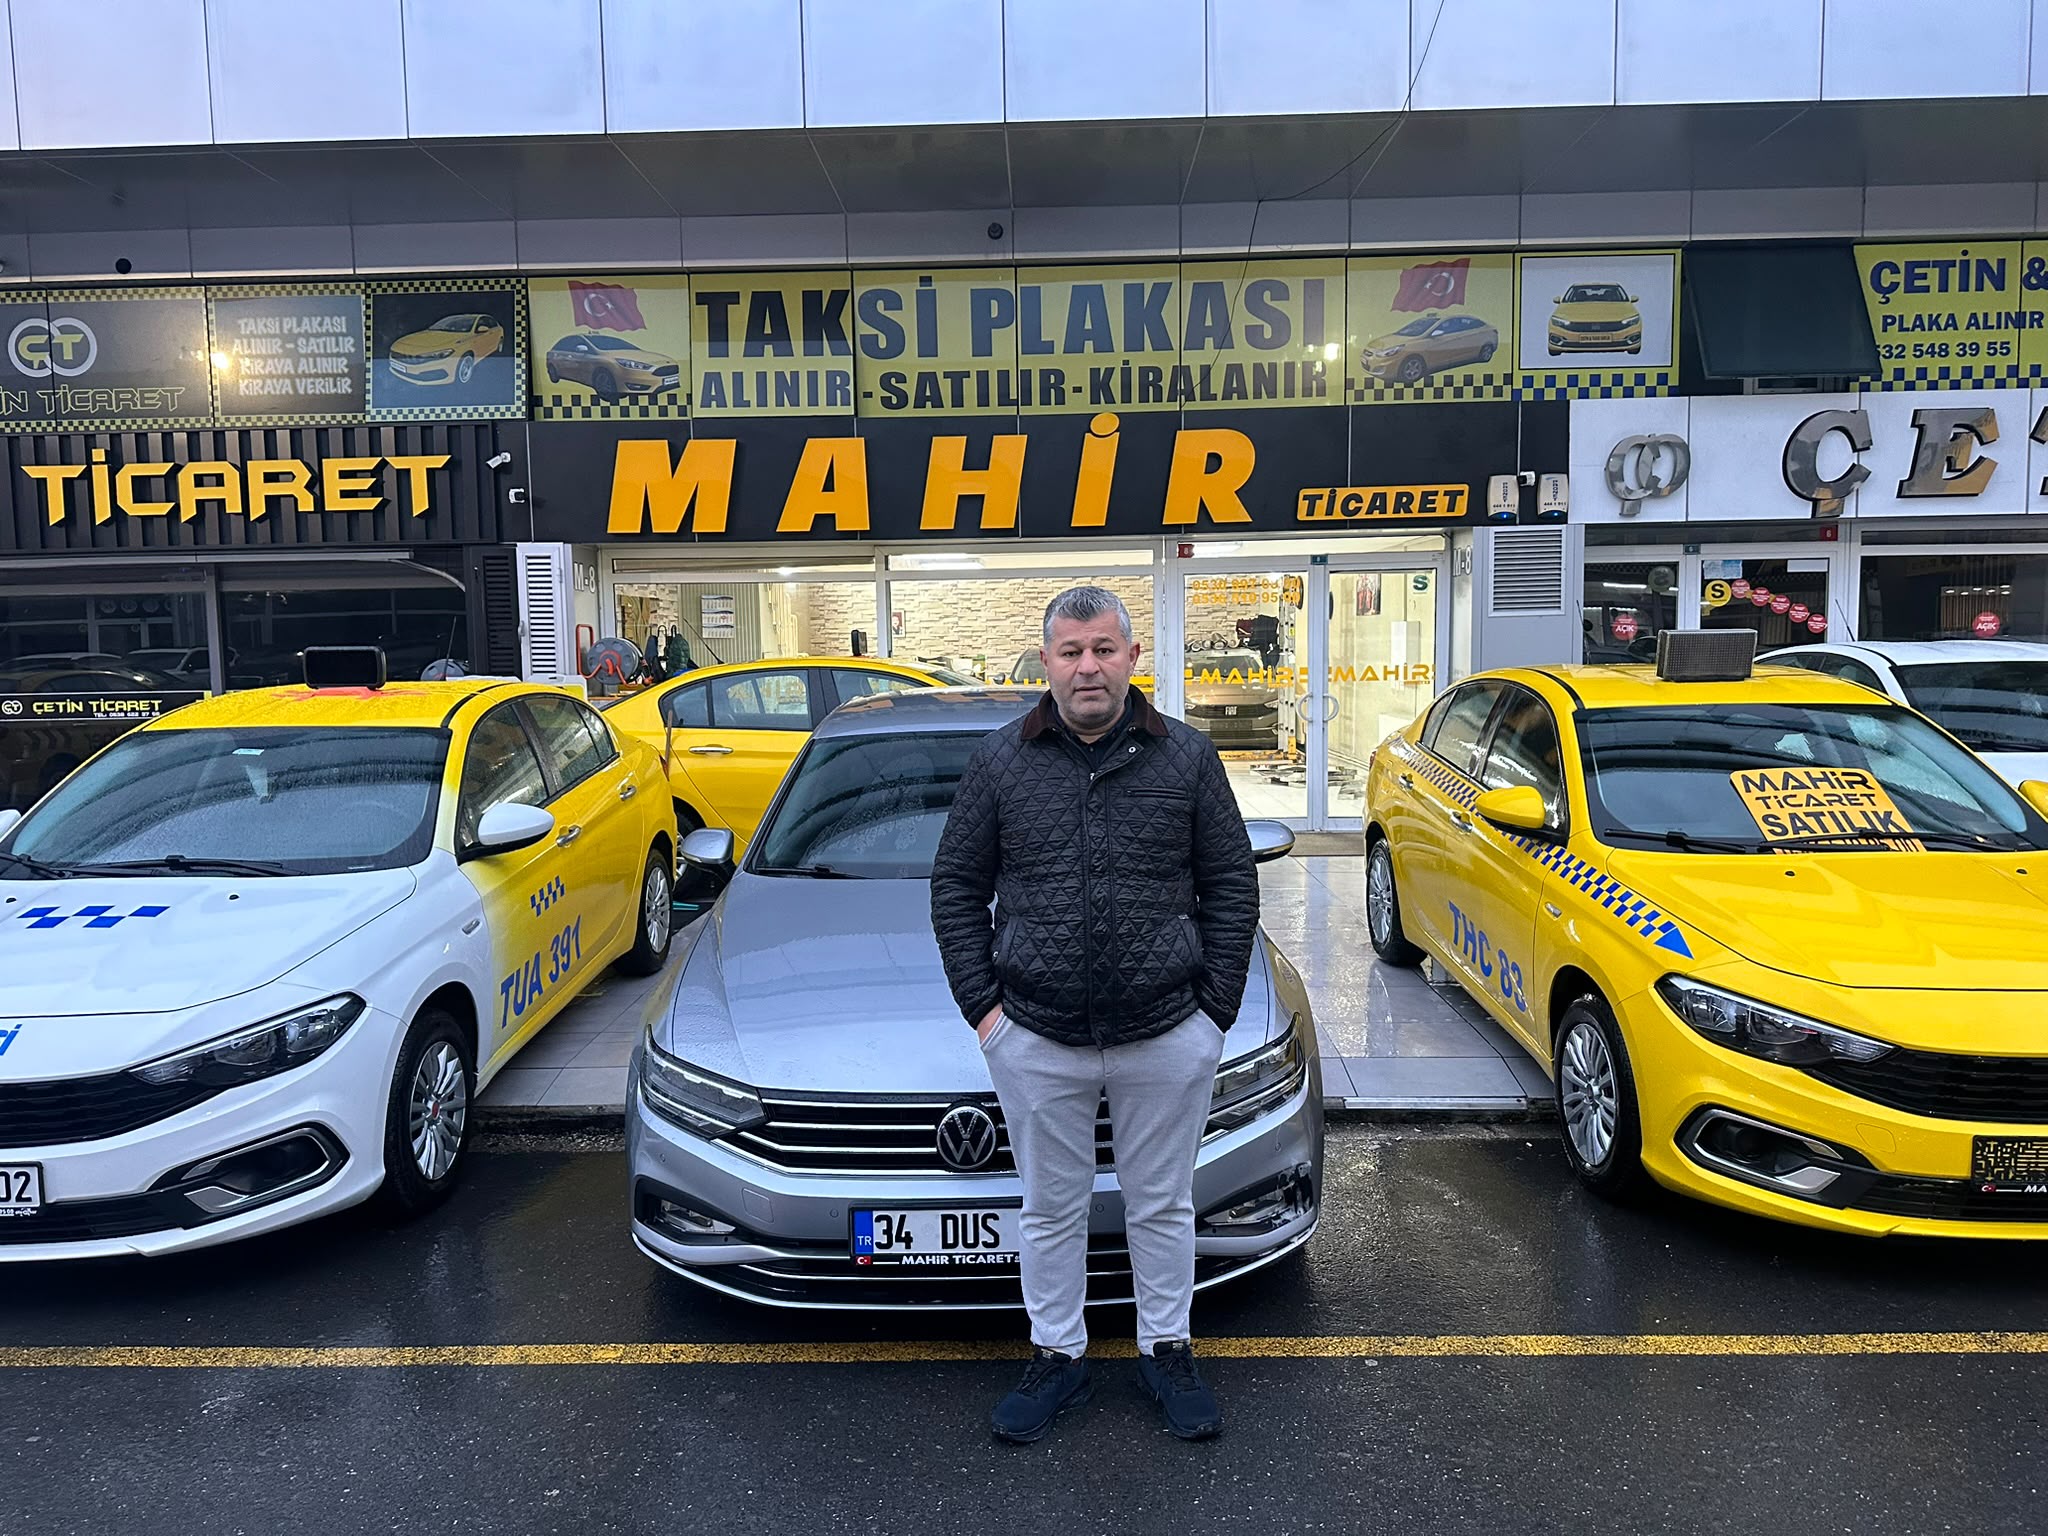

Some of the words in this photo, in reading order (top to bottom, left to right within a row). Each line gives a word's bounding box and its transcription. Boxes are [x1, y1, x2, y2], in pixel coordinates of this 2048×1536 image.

[1870, 249, 2006, 304] ÇETİN
[282, 316, 347, 334] PLAKASI
[696, 275, 938, 359] TAKSİ
[970, 279, 1325, 357] PLAKASI
[1882, 313, 1958, 333] PLAKA
[1965, 311, 2044, 331] ALINIR
[232, 338, 283, 355] ALINIR
[297, 336, 355, 354] SATILIR
[1912, 343, 1949, 359] 548
[1956, 342, 1980, 358] 39
[1987, 341, 2011, 356] 55
[298, 356, 348, 374] ALINIR
[37, 384, 185, 414] TİCARET
[607, 412, 1256, 534] MAHİR
[1782, 406, 2048, 518] ÇE
[20, 448, 452, 526] TİCARET
[1302, 488, 1465, 517] TİCARET
[574, 562, 596, 594] M-8
[1413, 575, 1428, 591] S
[1711, 583, 1724, 598] S
[33, 698, 83, 714] ÇETİN
[88, 698, 163, 713] TİCARET
[1761, 810, 1906, 837] SATILIK
[1448, 900, 1493, 977] THC
[1498, 949, 1526, 1012] 83
[500, 951, 543, 1029] TUA
[549, 914, 581, 984] 391
[857, 1235, 872, 1246] TR
[874, 1214, 913, 1250] 34
[940, 1213, 1000, 1250] DUS
